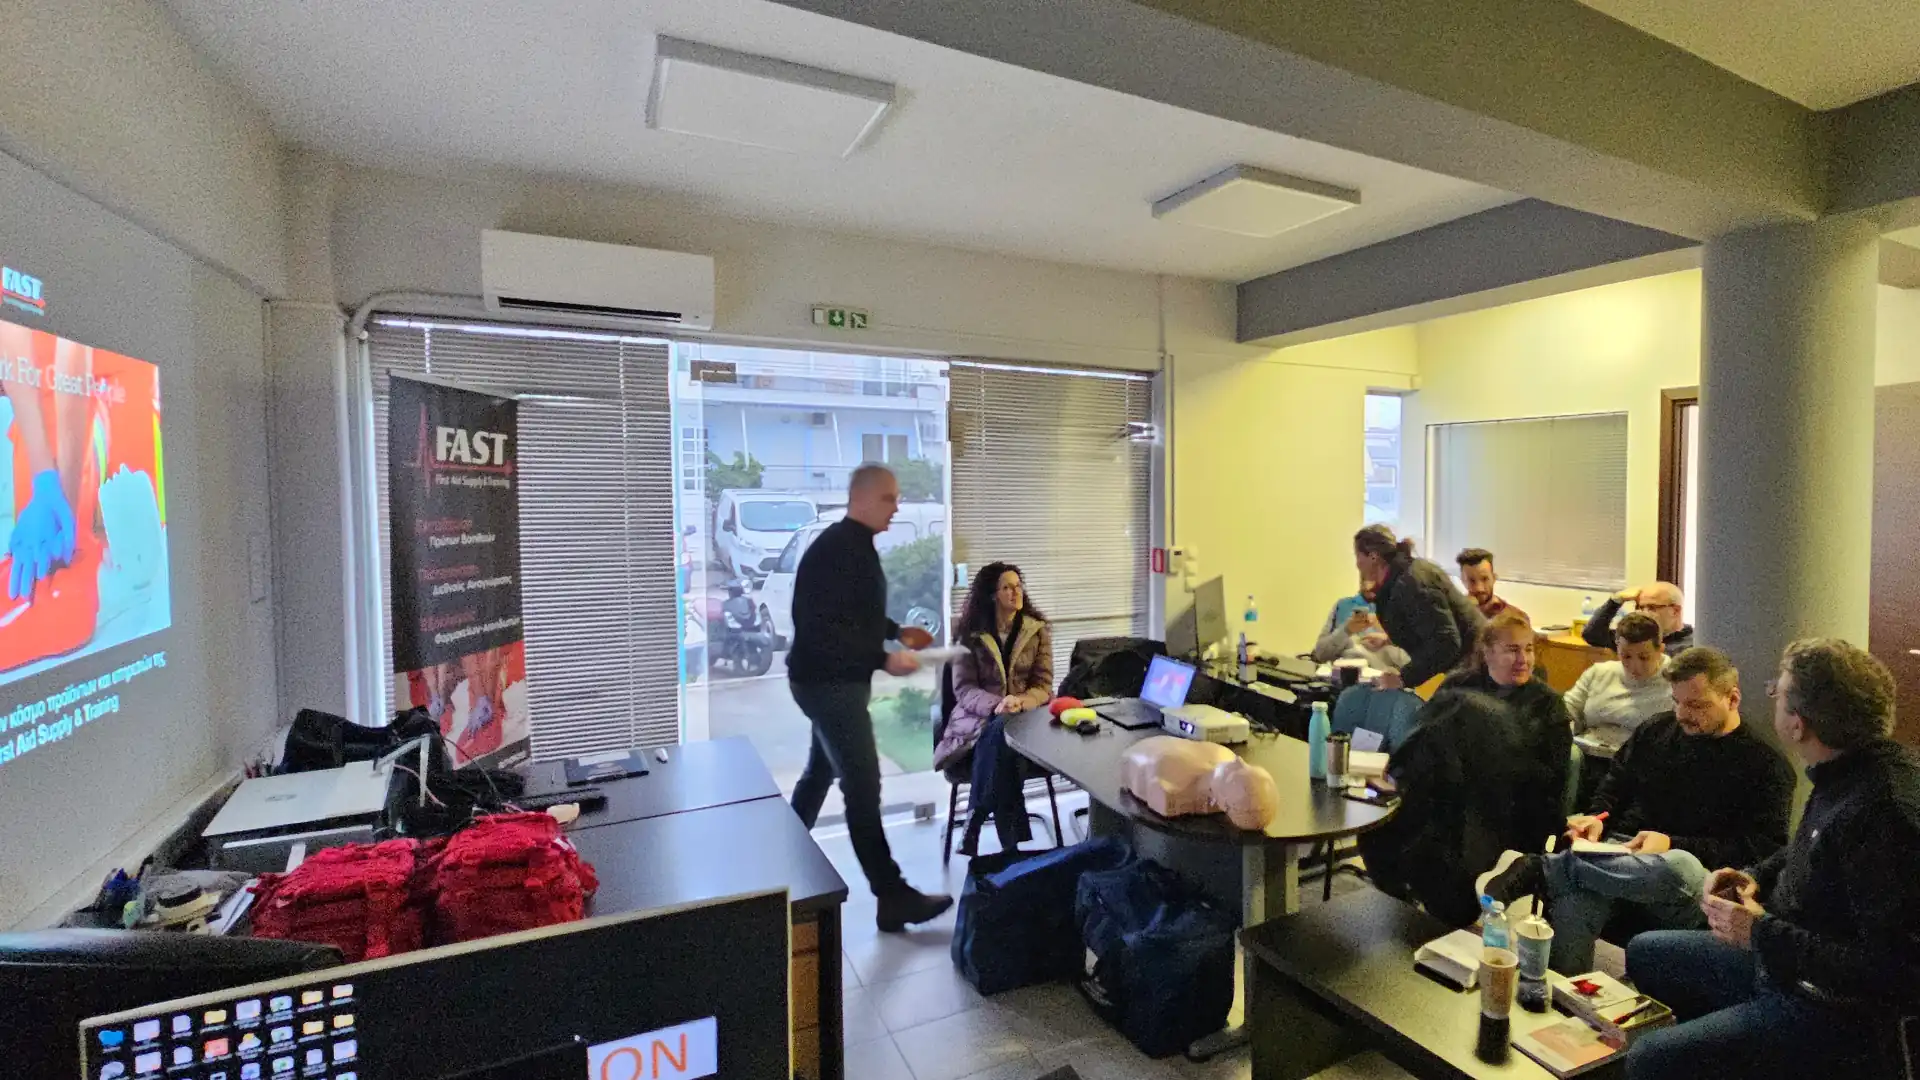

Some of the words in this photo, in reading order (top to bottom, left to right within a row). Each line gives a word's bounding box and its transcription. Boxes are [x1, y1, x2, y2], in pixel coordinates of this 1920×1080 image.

[2, 266, 43, 301] FAST
[17, 356, 42, 389] For
[46, 364, 83, 396] Great
[436, 426, 508, 465] FAST
[16, 729, 37, 757] Aid
[37, 714, 73, 745] Supply
[74, 707, 83, 727] &
[83, 695, 120, 722] Training
[601, 1032, 688, 1080] ON
